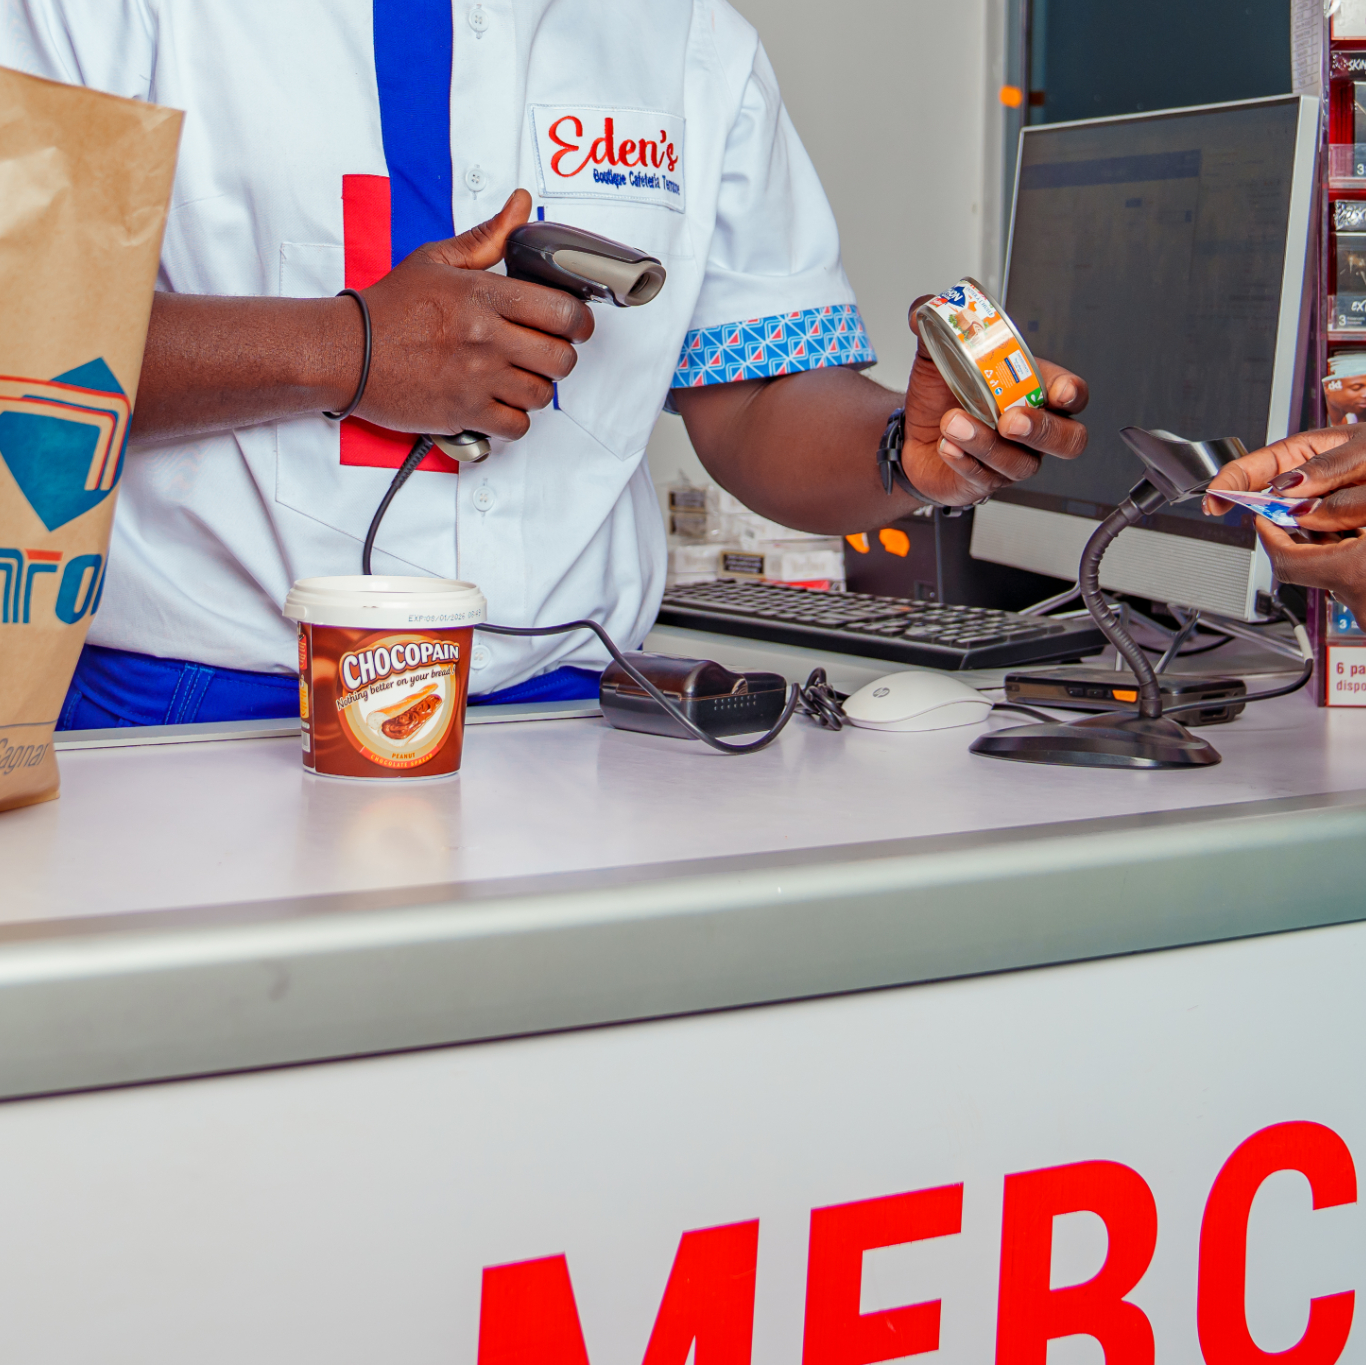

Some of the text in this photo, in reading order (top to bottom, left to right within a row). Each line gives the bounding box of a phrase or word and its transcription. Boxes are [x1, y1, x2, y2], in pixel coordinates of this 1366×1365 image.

[548, 115, 678, 178] Eden's
[1357, 163, 1365, 175] 3
[1338, 315, 1346, 326] 3
[1339, 619, 1347, 630] 3
[343, 643, 459, 690] CHOCOPAIN
[1336, 662, 1344, 674] 6
[336, 691, 369, 711] Nothing
[370, 680, 394, 695] better
[397, 678, 408, 687] on
[410, 672, 429, 687] your
[431, 668, 451, 679] bread
[370, 753, 433, 767] CHOCOLATE SPREAD
